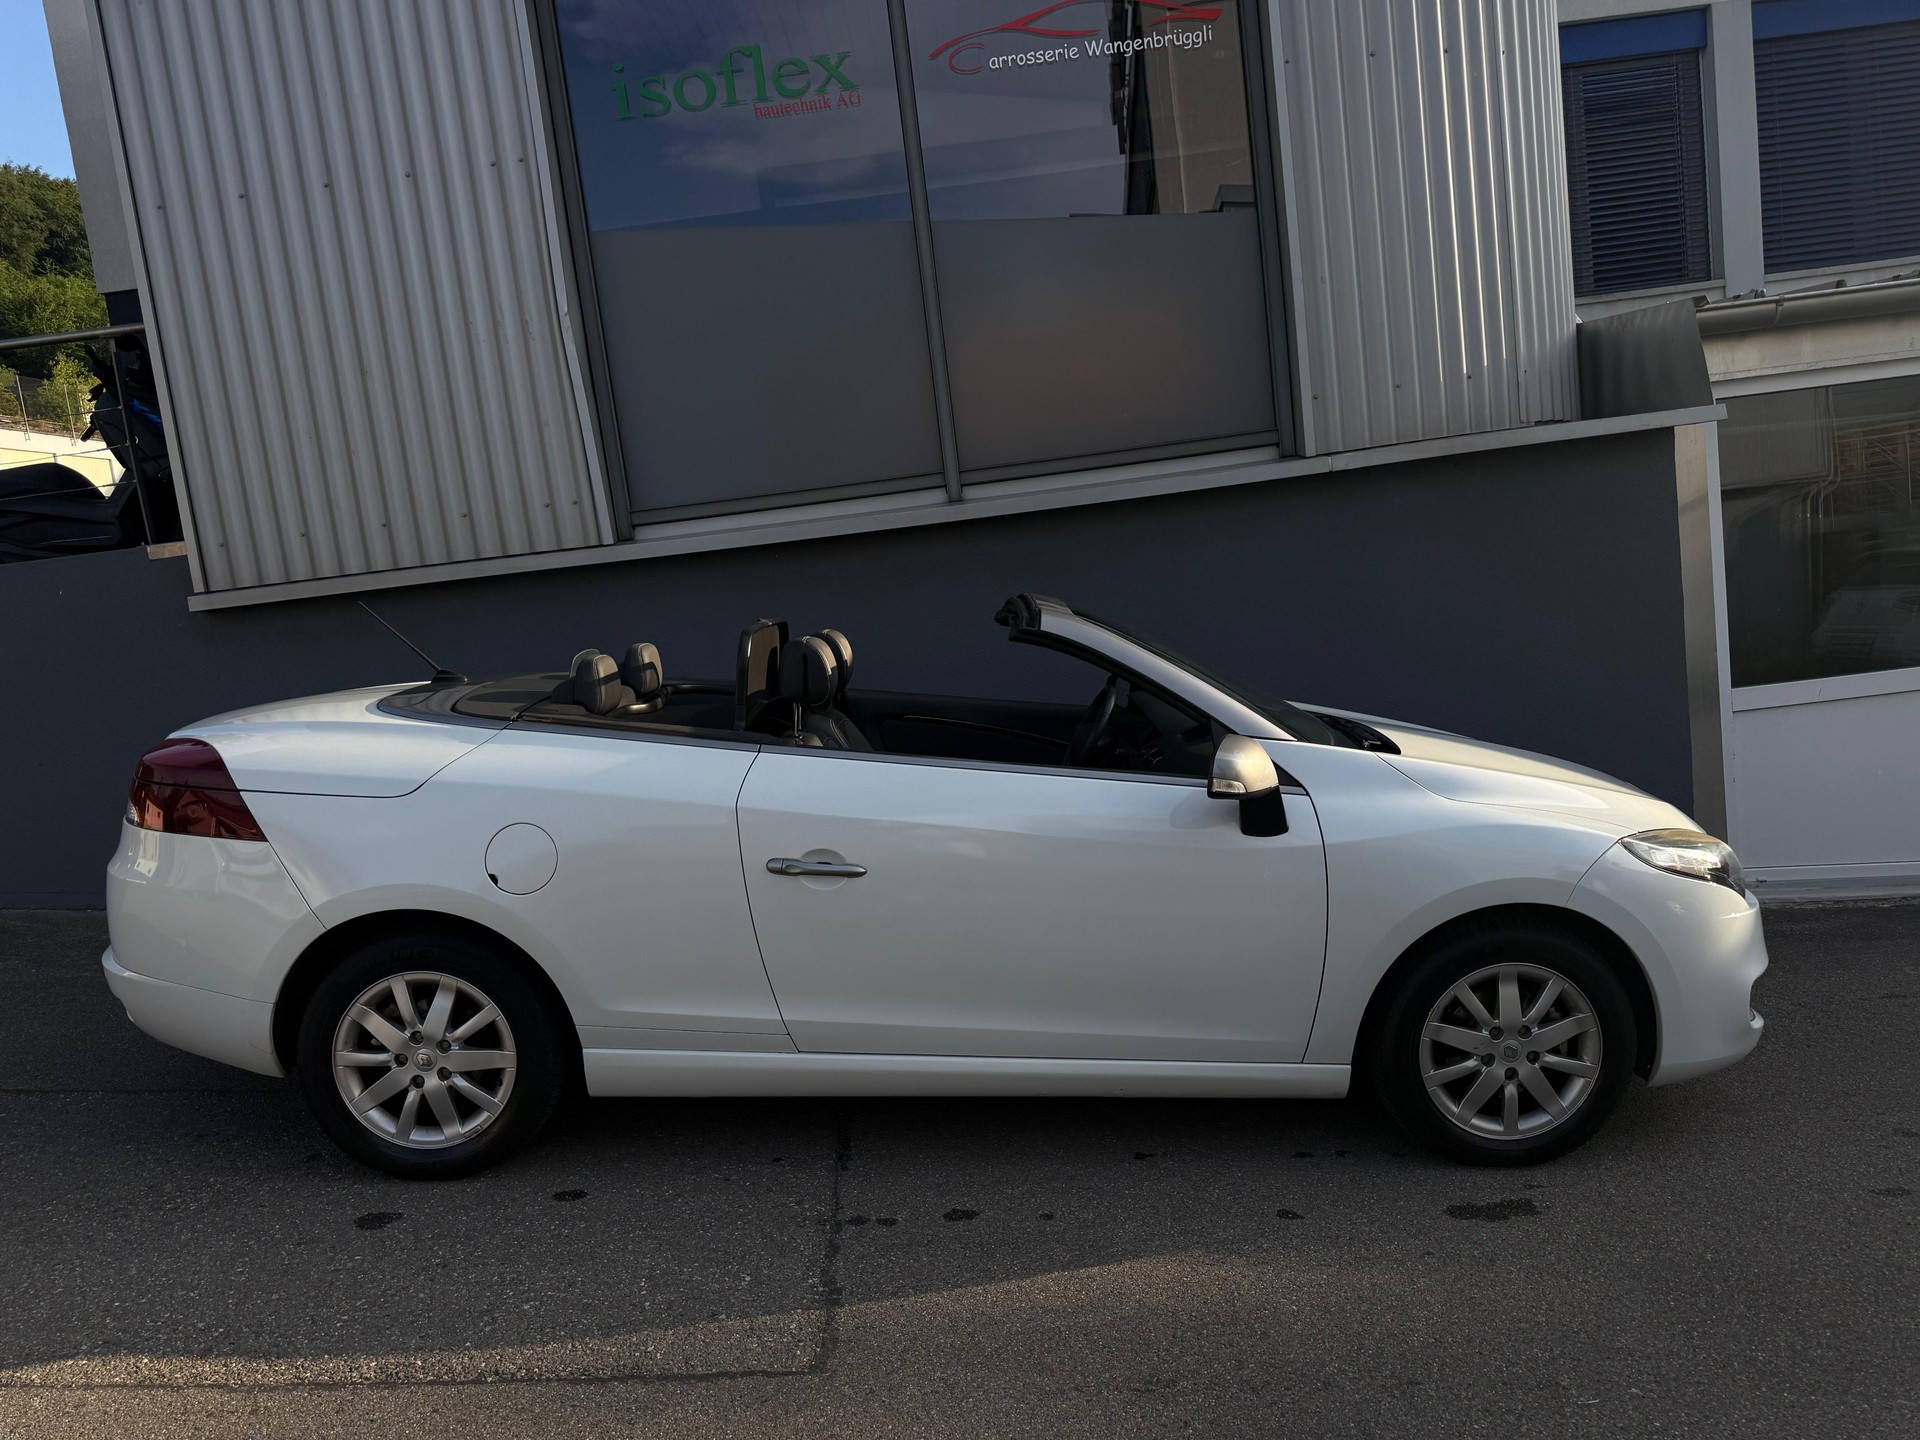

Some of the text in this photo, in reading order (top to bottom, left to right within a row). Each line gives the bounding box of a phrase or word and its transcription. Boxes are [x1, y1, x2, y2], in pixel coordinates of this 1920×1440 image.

[1084, 25, 1213, 57] Wangenbrüggli
[611, 43, 859, 120] isoflex
[752, 90, 861, 120] bautechnik AG
